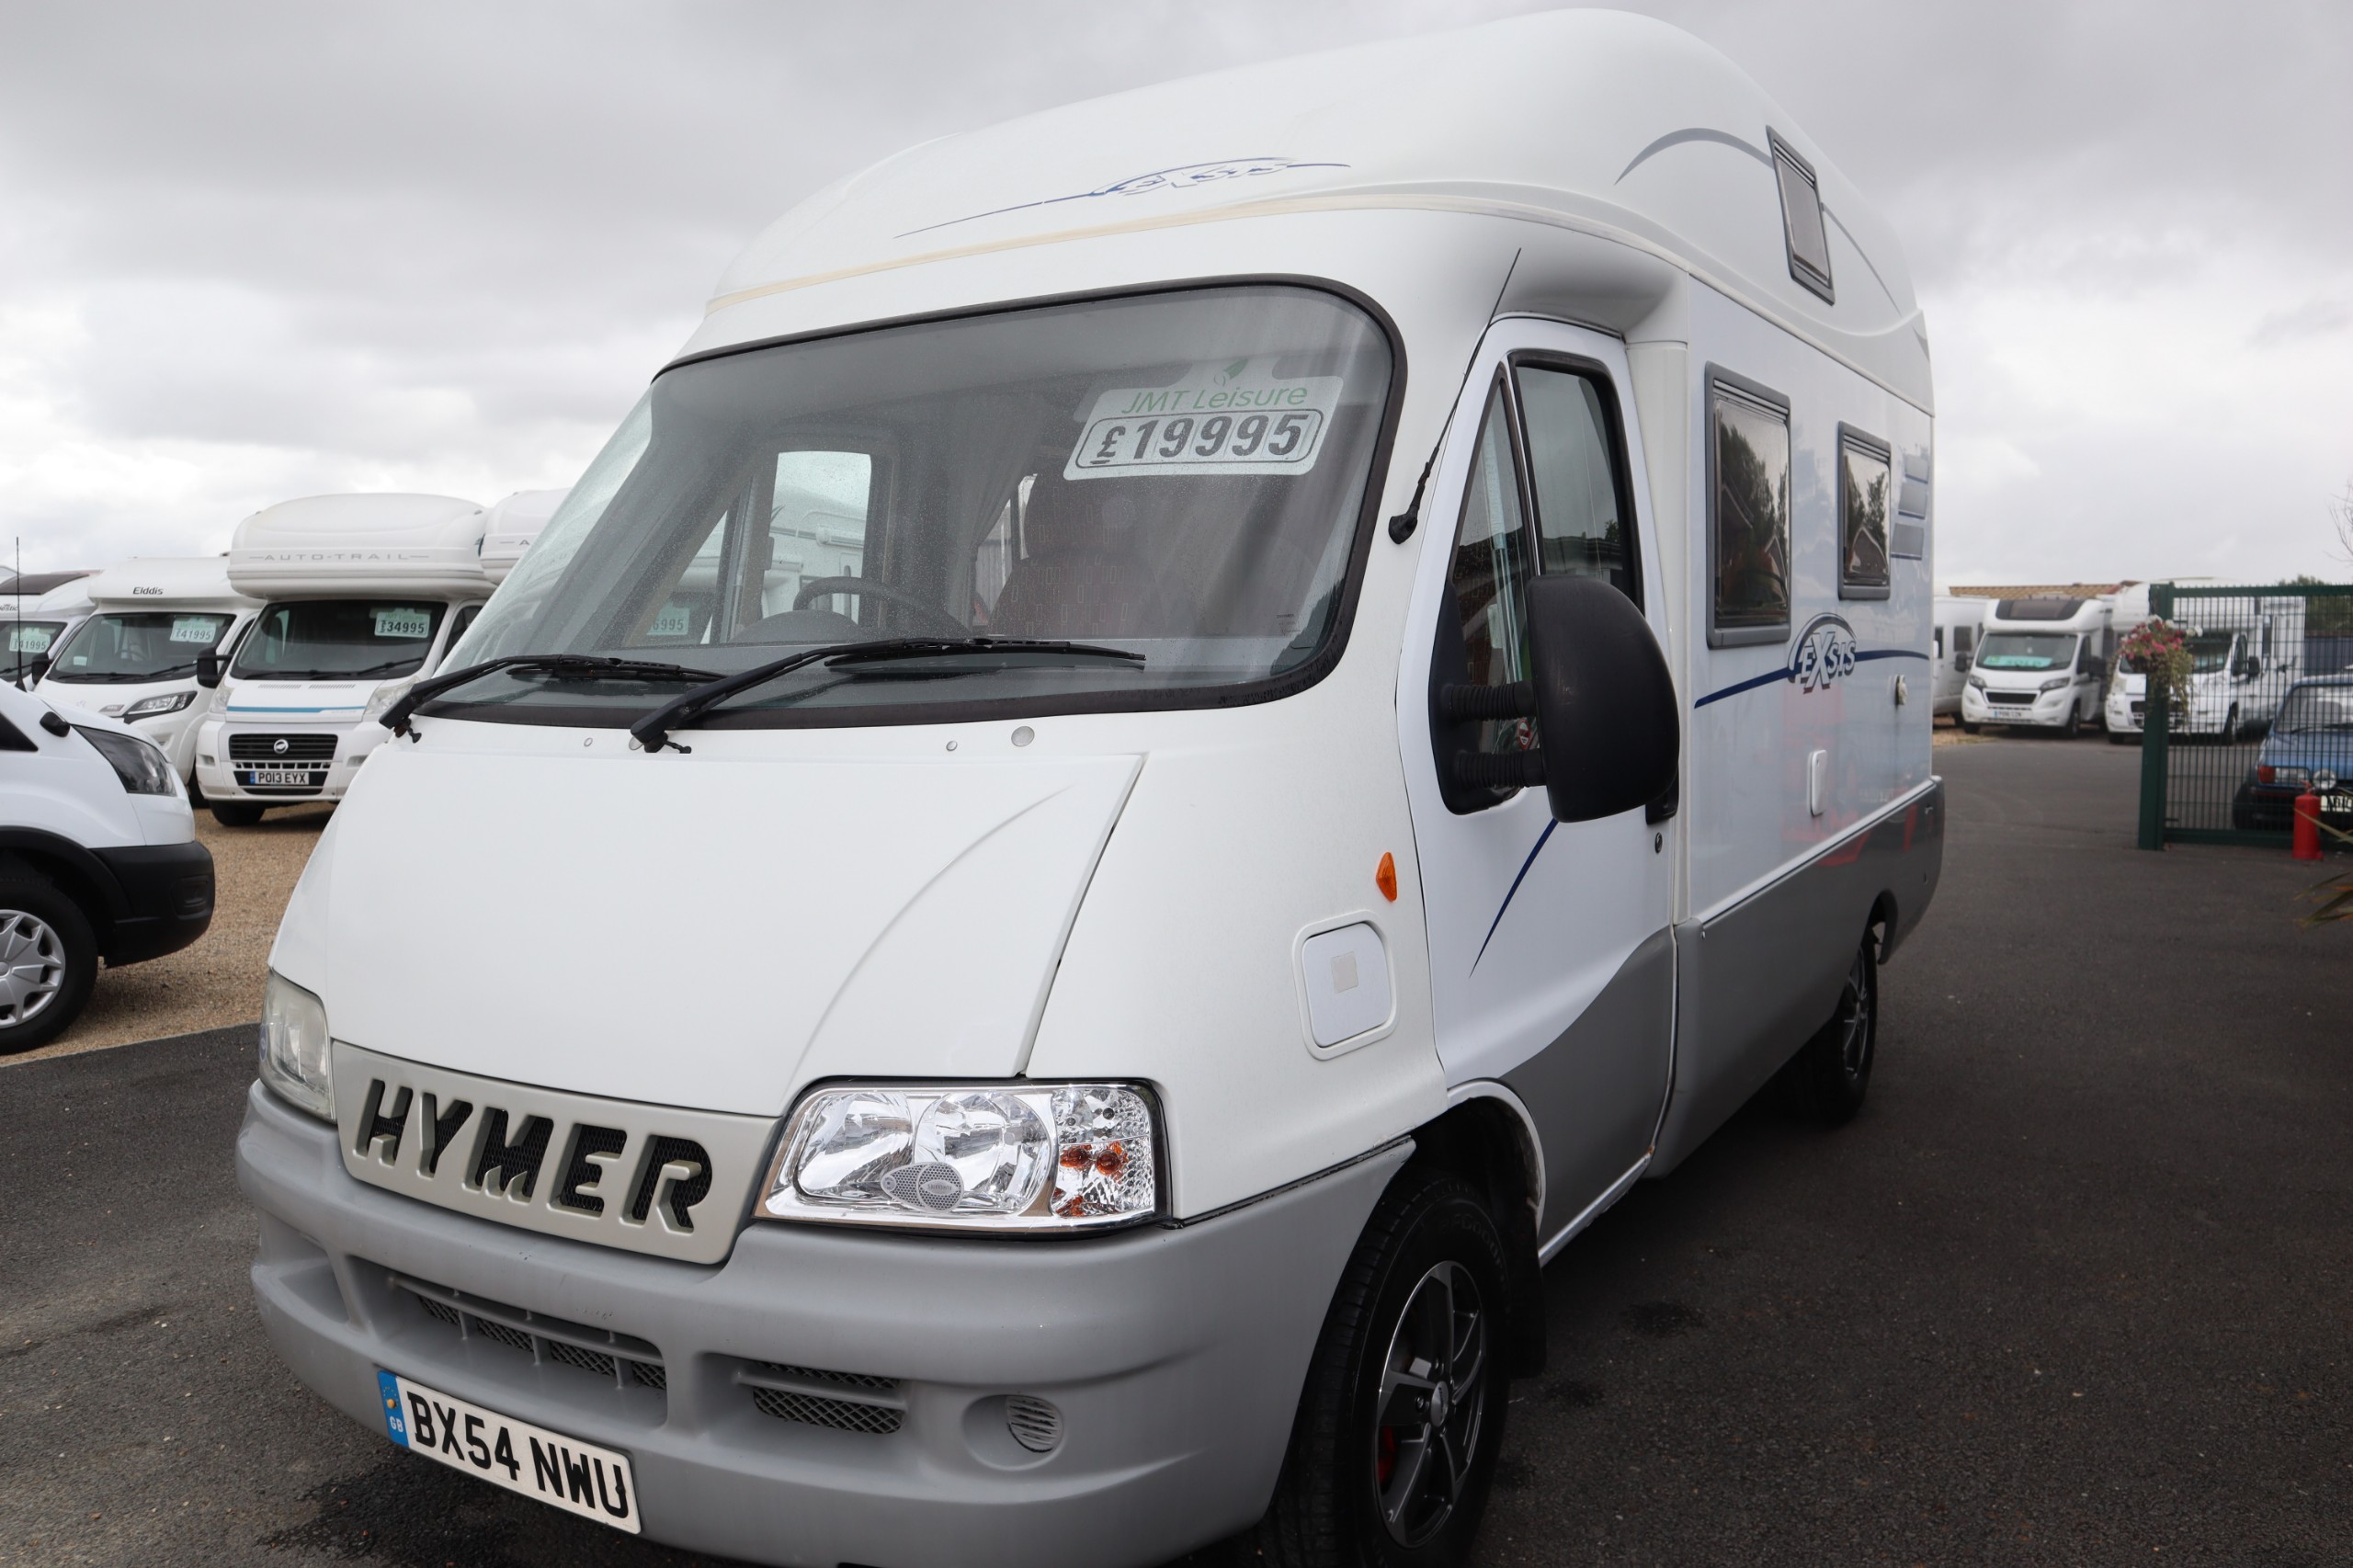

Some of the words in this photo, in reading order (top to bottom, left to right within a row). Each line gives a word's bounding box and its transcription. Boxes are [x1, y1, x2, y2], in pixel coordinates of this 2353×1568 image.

[1121, 390, 1190, 414] JMT
[1193, 386, 1308, 410] Leisure
[1090, 414, 1310, 464] £19995
[132, 586, 164, 595] Elddis
[380, 619, 425, 633] £34995
[1801, 631, 1857, 694] EXSIS
[258, 772, 282, 783] PO13
[284, 772, 306, 783] EYX
[352, 1078, 713, 1235] HYMER
[389, 1415, 404, 1433] GB
[406, 1391, 521, 1482] BX54
[529, 1436, 629, 1519] NWU
